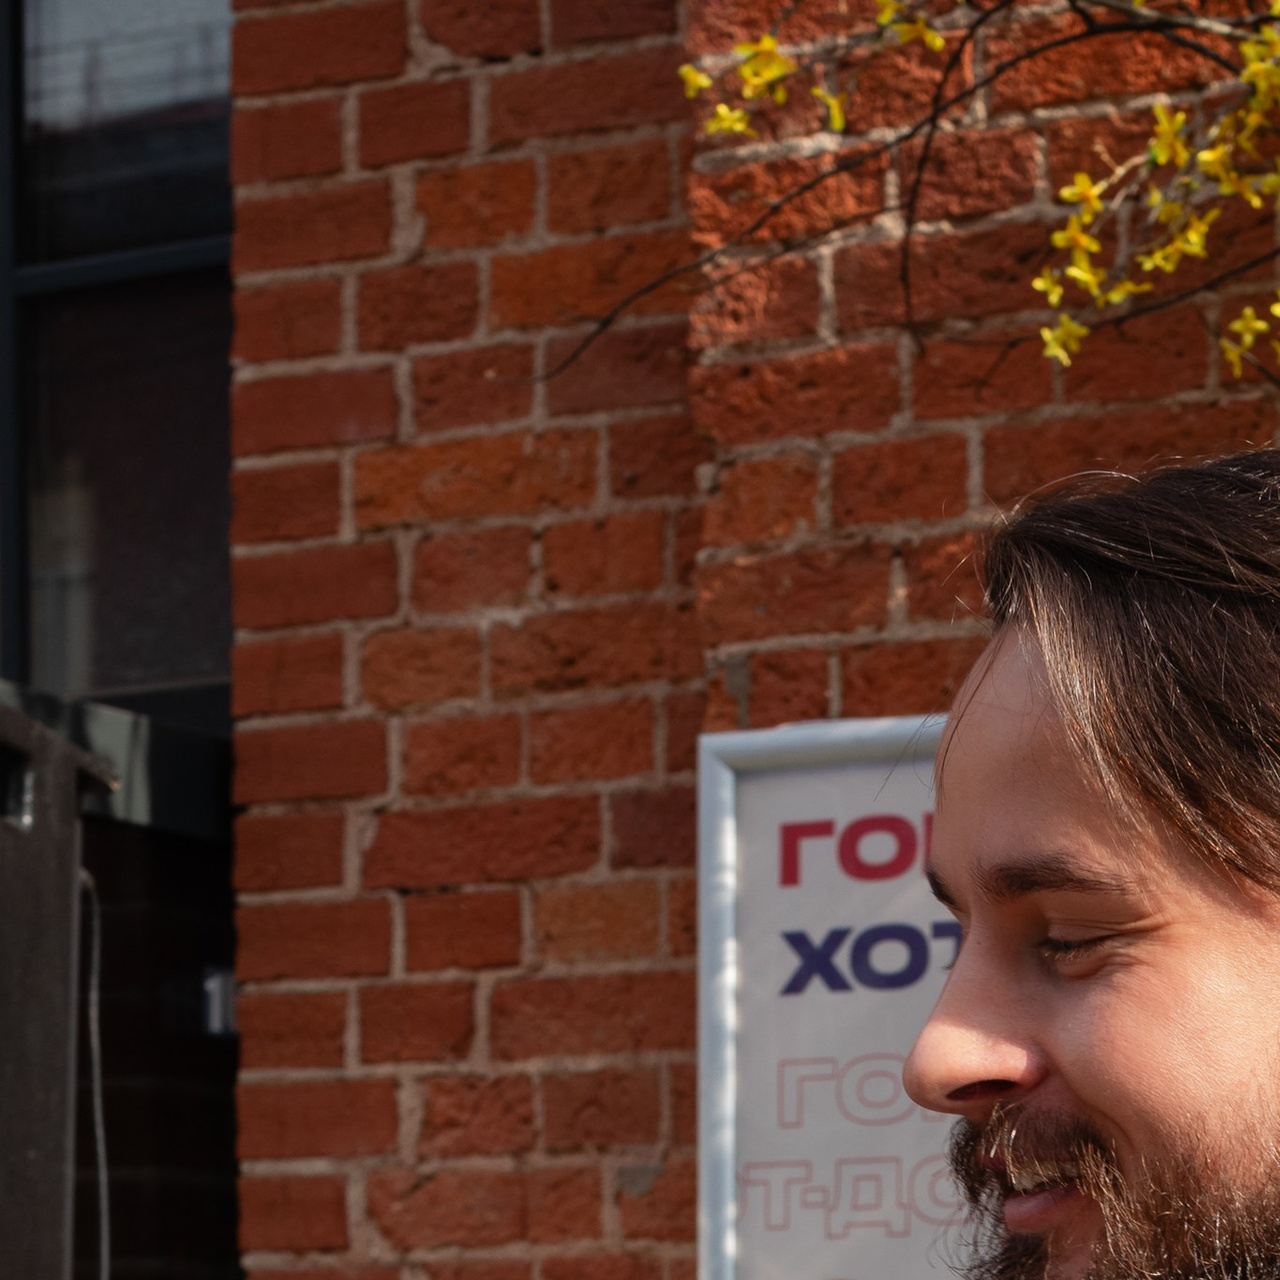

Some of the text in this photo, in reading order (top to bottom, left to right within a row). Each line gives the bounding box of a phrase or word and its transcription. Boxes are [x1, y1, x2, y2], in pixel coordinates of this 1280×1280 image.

[778, 810, 935, 889] ГО
[776, 1053, 947, 1130] ГО
[737, 1153, 976, 1240] Т-ДО
